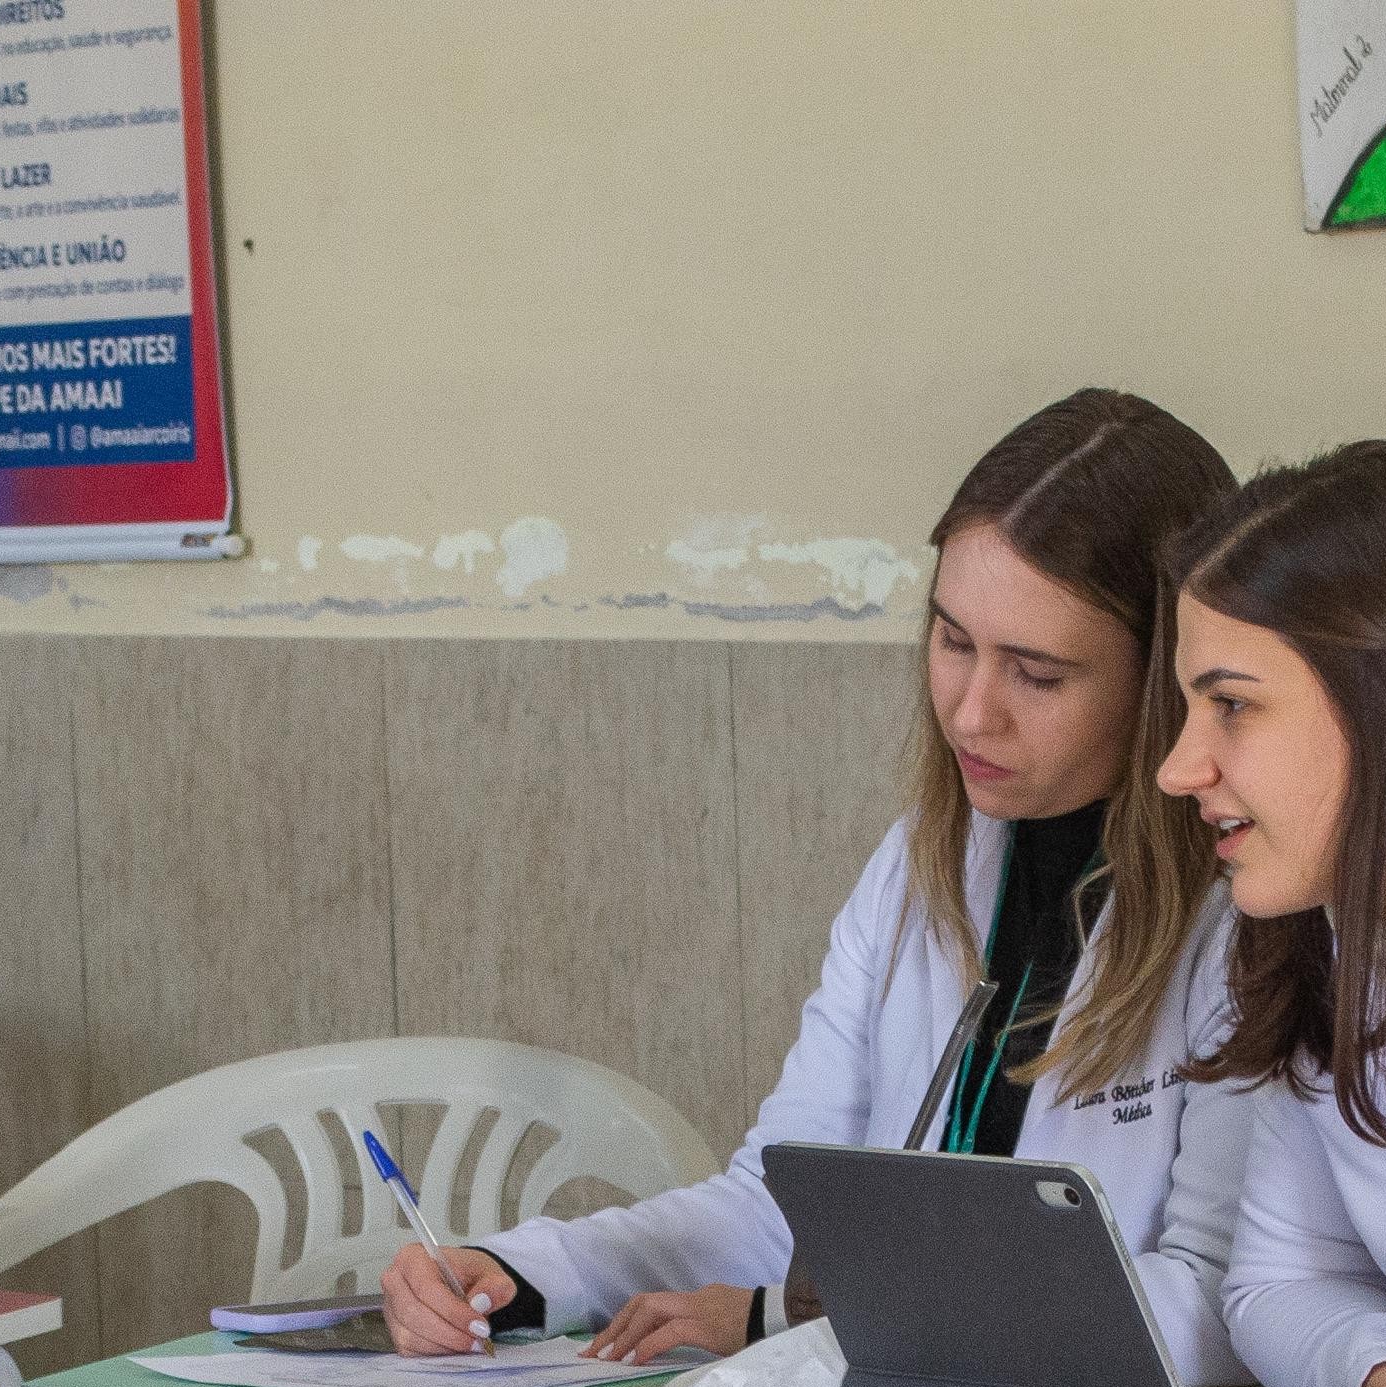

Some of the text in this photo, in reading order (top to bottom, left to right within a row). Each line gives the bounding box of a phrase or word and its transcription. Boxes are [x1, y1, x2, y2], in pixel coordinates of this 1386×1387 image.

[1, 162, 52, 189] LAZER
[52, 242, 62, 267] E
[65, 234, 126, 265] UNIÃO
[32, 338, 86, 371] MAIS
[88, 334, 176, 368] FORTES!
[16, 382, 47, 413] DA
[50, 379, 123, 411] AMAAI
